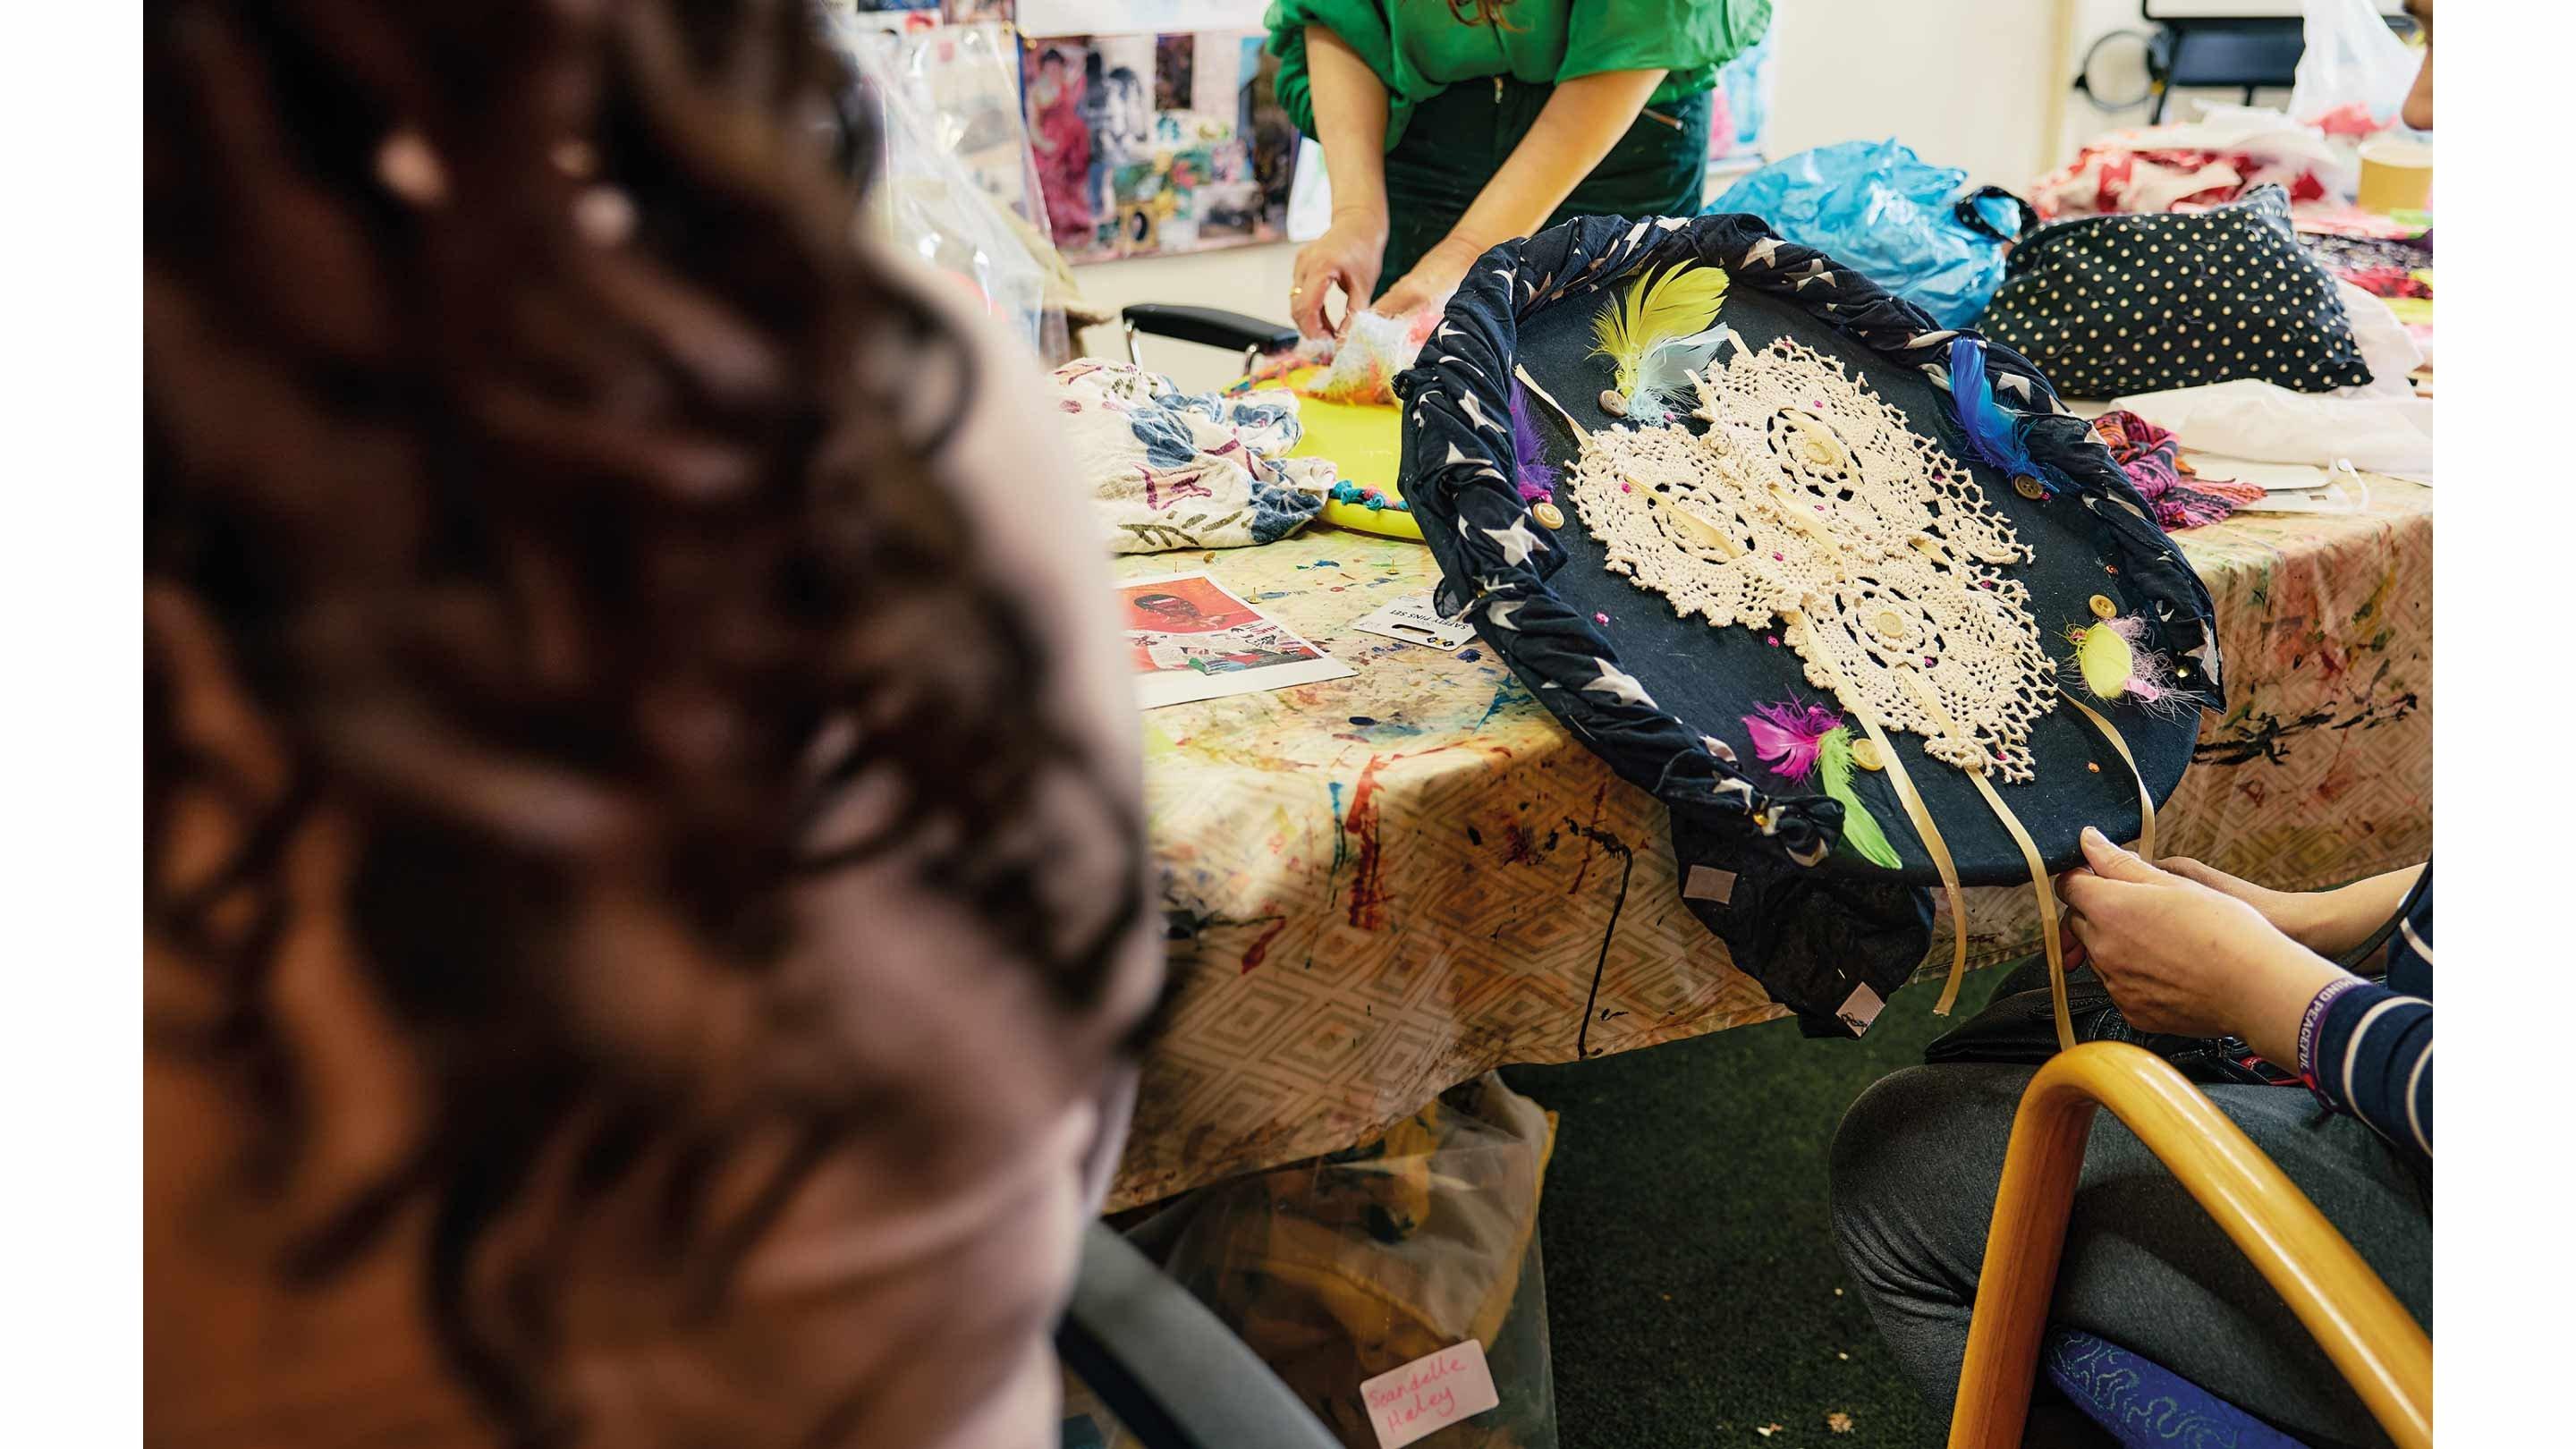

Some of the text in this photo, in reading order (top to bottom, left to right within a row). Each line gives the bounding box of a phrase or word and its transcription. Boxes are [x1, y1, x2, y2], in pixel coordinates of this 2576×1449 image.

[1390, 609, 1407, 617] SET
[1408, 614, 1431, 623] PINS
[2299, 1000, 2325, 1069] PEACEFUL
